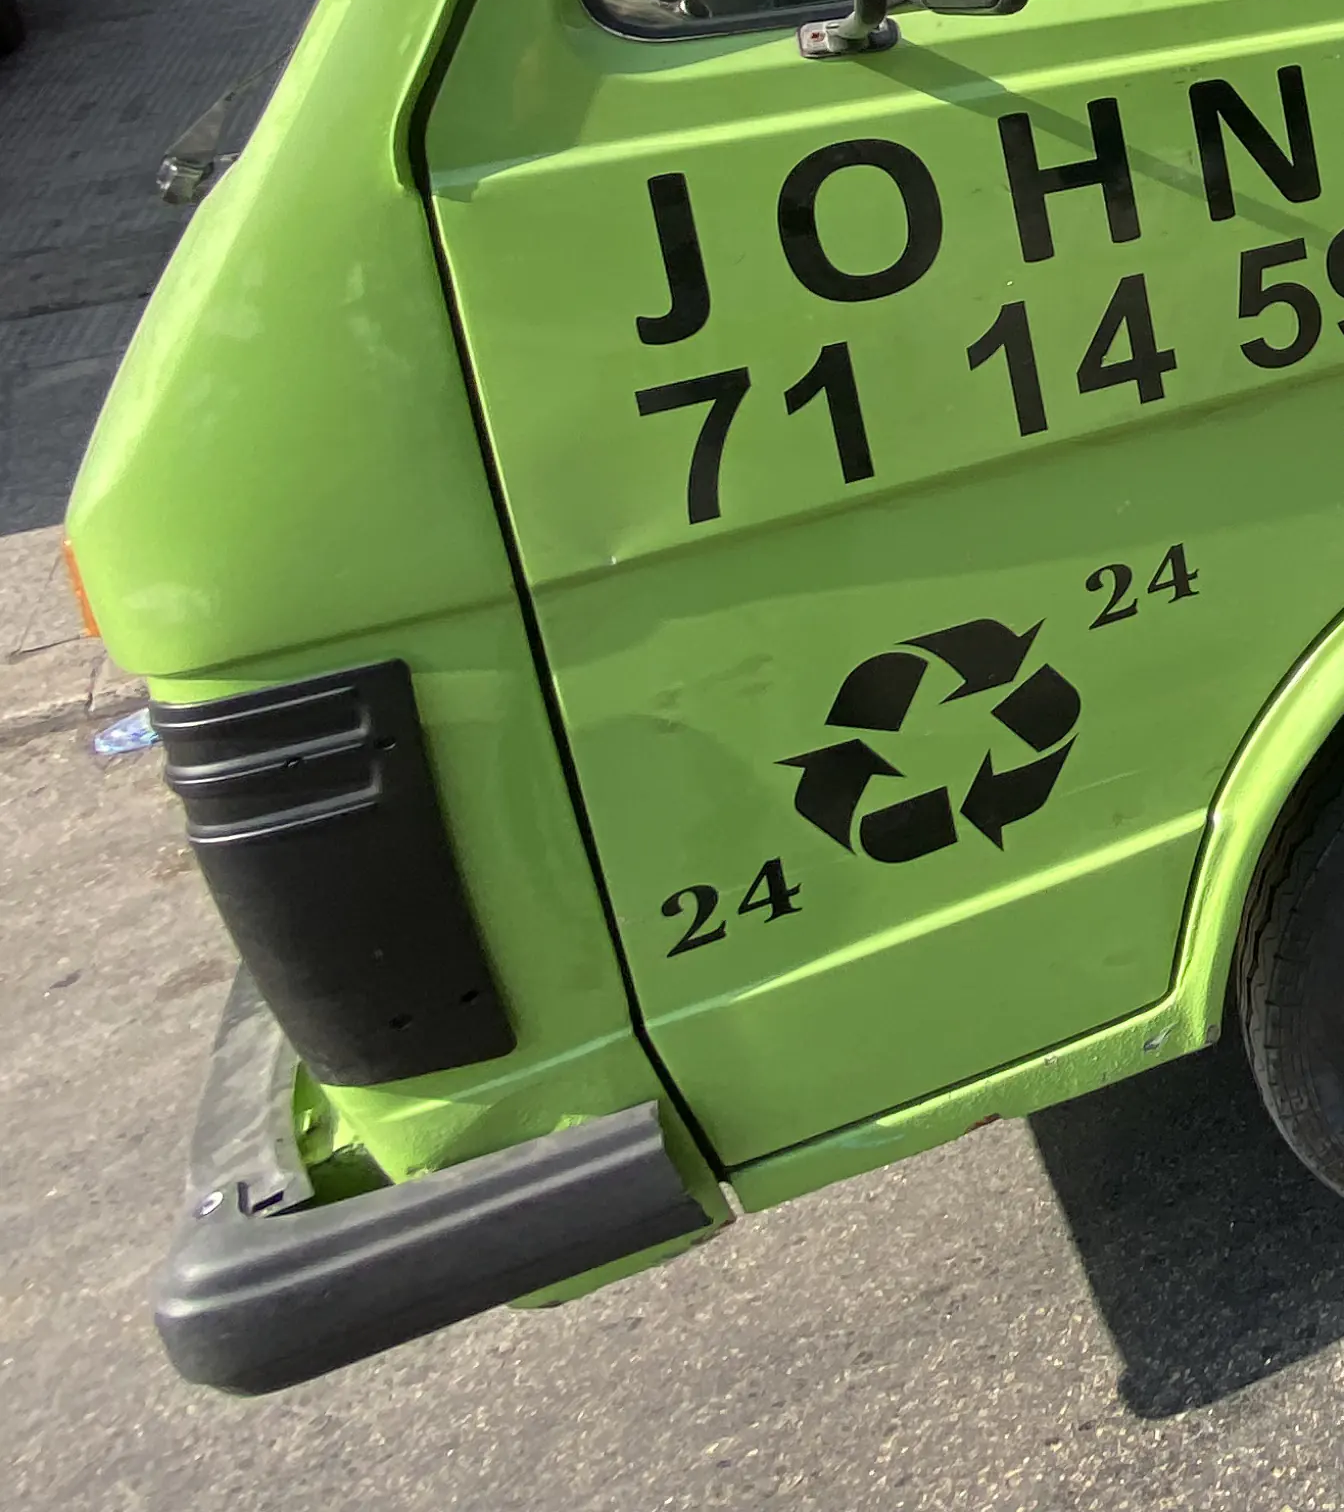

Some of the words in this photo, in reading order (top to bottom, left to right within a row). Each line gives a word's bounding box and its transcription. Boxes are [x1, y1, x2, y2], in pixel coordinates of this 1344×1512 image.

[634, 340, 875, 525] 71
[966, 273, 1177, 438] 14
[1085, 542, 1200, 629] 24
[661, 857, 802, 958] 24
